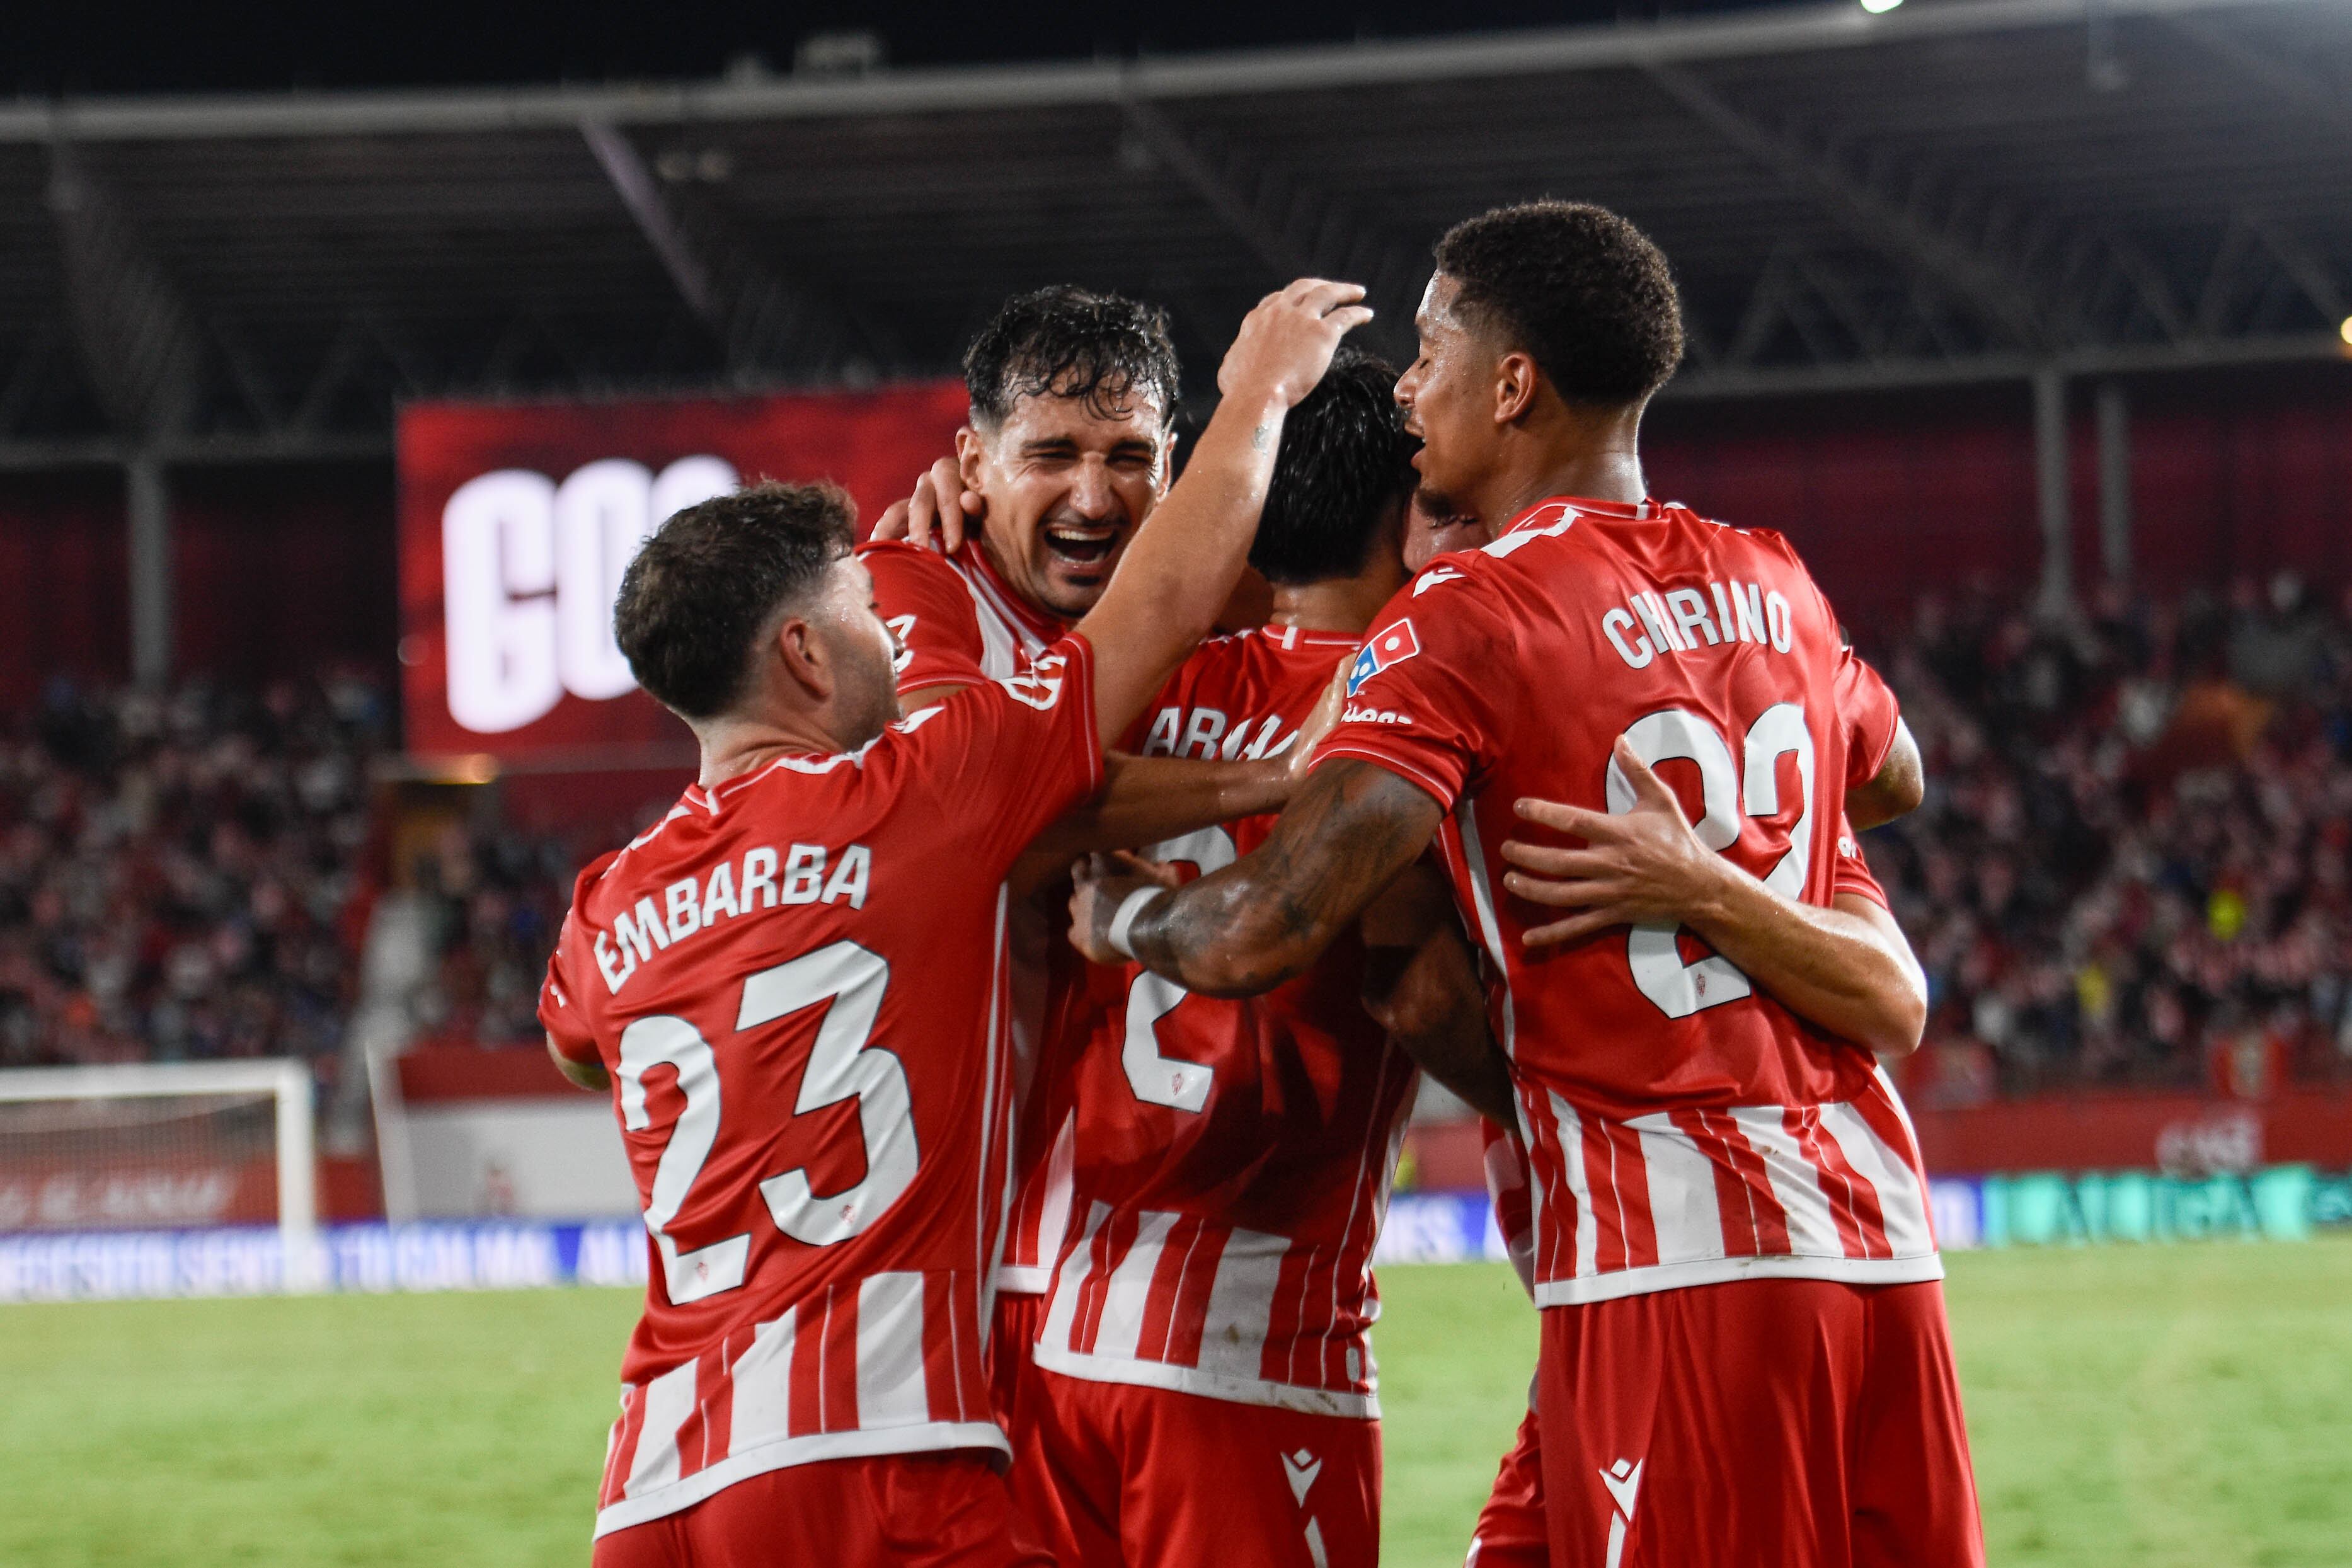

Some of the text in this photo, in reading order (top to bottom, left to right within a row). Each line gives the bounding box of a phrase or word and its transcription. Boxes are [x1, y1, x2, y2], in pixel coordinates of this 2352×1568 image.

[443, 454, 738, 733] GO
[594, 844, 871, 995] EMBARBA
[1606, 702, 1815, 1020] 22
[615, 939, 919, 1307] 23
